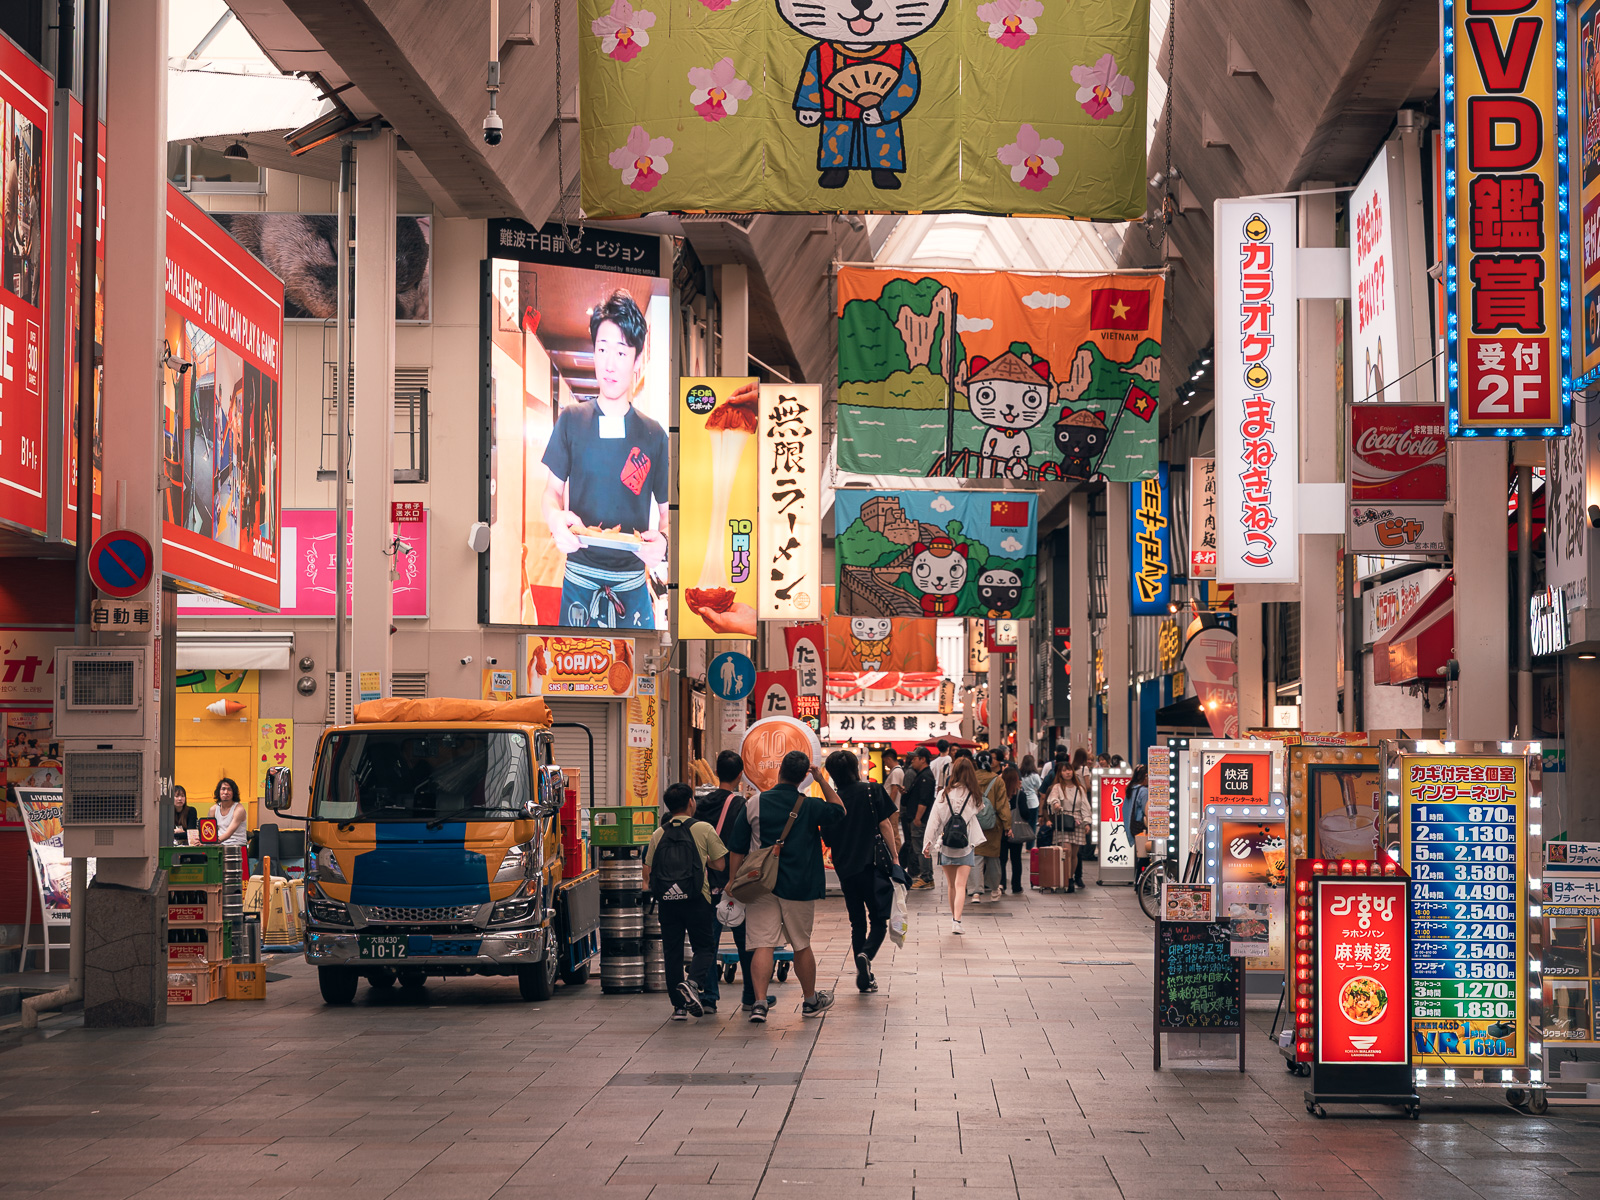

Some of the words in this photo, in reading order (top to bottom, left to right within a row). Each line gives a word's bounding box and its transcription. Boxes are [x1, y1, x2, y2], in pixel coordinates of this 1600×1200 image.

[1465, 0, 1546, 334] VD鑑賞
[499, 228, 566, 254] 難波千日前
[595, 240, 645, 262] ビジョン
[594, 263, 616, 272] produced
[165, 256, 202, 316] CHALLENGE
[218, 296, 229, 335] YOU
[229, 306, 241, 344] CAN
[242, 315, 256, 355] PLAY
[1241, 241, 1274, 365] カラオケ
[1100, 331, 1139, 342] VIETNAM
[27, 343, 38, 373] 300
[1477, 342, 1541, 371] 受付
[1477, 374, 1542, 413] 2F
[1379, 425, 1398, 433] Enjoy!
[1240, 394, 1276, 567] まねきねこ
[767, 394, 813, 609] 無限ラーメン
[252, 534, 262, 559] and
[729, 519, 752, 583] 10円パン
[93, 607, 150, 625] 自動車
[556, 654, 608, 672] 10円パン
[548, 683, 561, 691] SNS
[768, 692, 787, 712] た
[273, 722, 291, 765] あげサ
[761, 730, 787, 758] 10
[1102, 778, 1131, 786] ホルモン
[1225, 768, 1249, 780] 快活
[1410, 764, 1516, 783] カギ付完全個室
[1225, 781, 1249, 790] CLUB
[1410, 783, 1516, 802] インターネット
[1109, 786, 1126, 853] らーめん
[1416, 806, 1444, 822] 1時間
[1468, 806, 1515, 823] 870円
[1416, 825, 1444, 841] 2時間
[1454, 826, 1515, 842] 1,130円
[1415, 845, 1444, 861] 5時間
[1454, 845, 1515, 861] 2,140円
[1414, 864, 1444, 880] 12時間
[1454, 865, 1515, 881] 3,580円
[662, 892, 688, 901] adidas
[1414, 884, 1444, 900] 24時間
[1454, 884, 1515, 901] 4,490円
[169, 907, 204, 915] アサヒビール
[1414, 902, 1448, 910] ナイトコース
[1454, 904, 1515, 920] 2,540円
[1414, 922, 1448, 930] ナイトコース
[1454, 923, 1515, 940] 2,240円
[362, 948, 369, 956] あ
[370, 943, 406, 957] 10-12
[1334, 942, 1393, 962] 麻辣烫
[1454, 942, 1515, 959] 2,540円
[1337, 962, 1390, 971] マーラータン
[1414, 962, 1446, 970] ワンデイ
[1454, 962, 1515, 979] 3,580円
[1414, 986, 1442, 998] 3時間
[1453, 982, 1515, 999] 1,270円
[1414, 1006, 1442, 1017] 6時間
[1453, 1002, 1515, 1018] 1,830円
[1460, 1021, 1487, 1038] 1時間
[1414, 1031, 1461, 1055] VR
[1462, 1038, 1515, 1056] 1,630円
